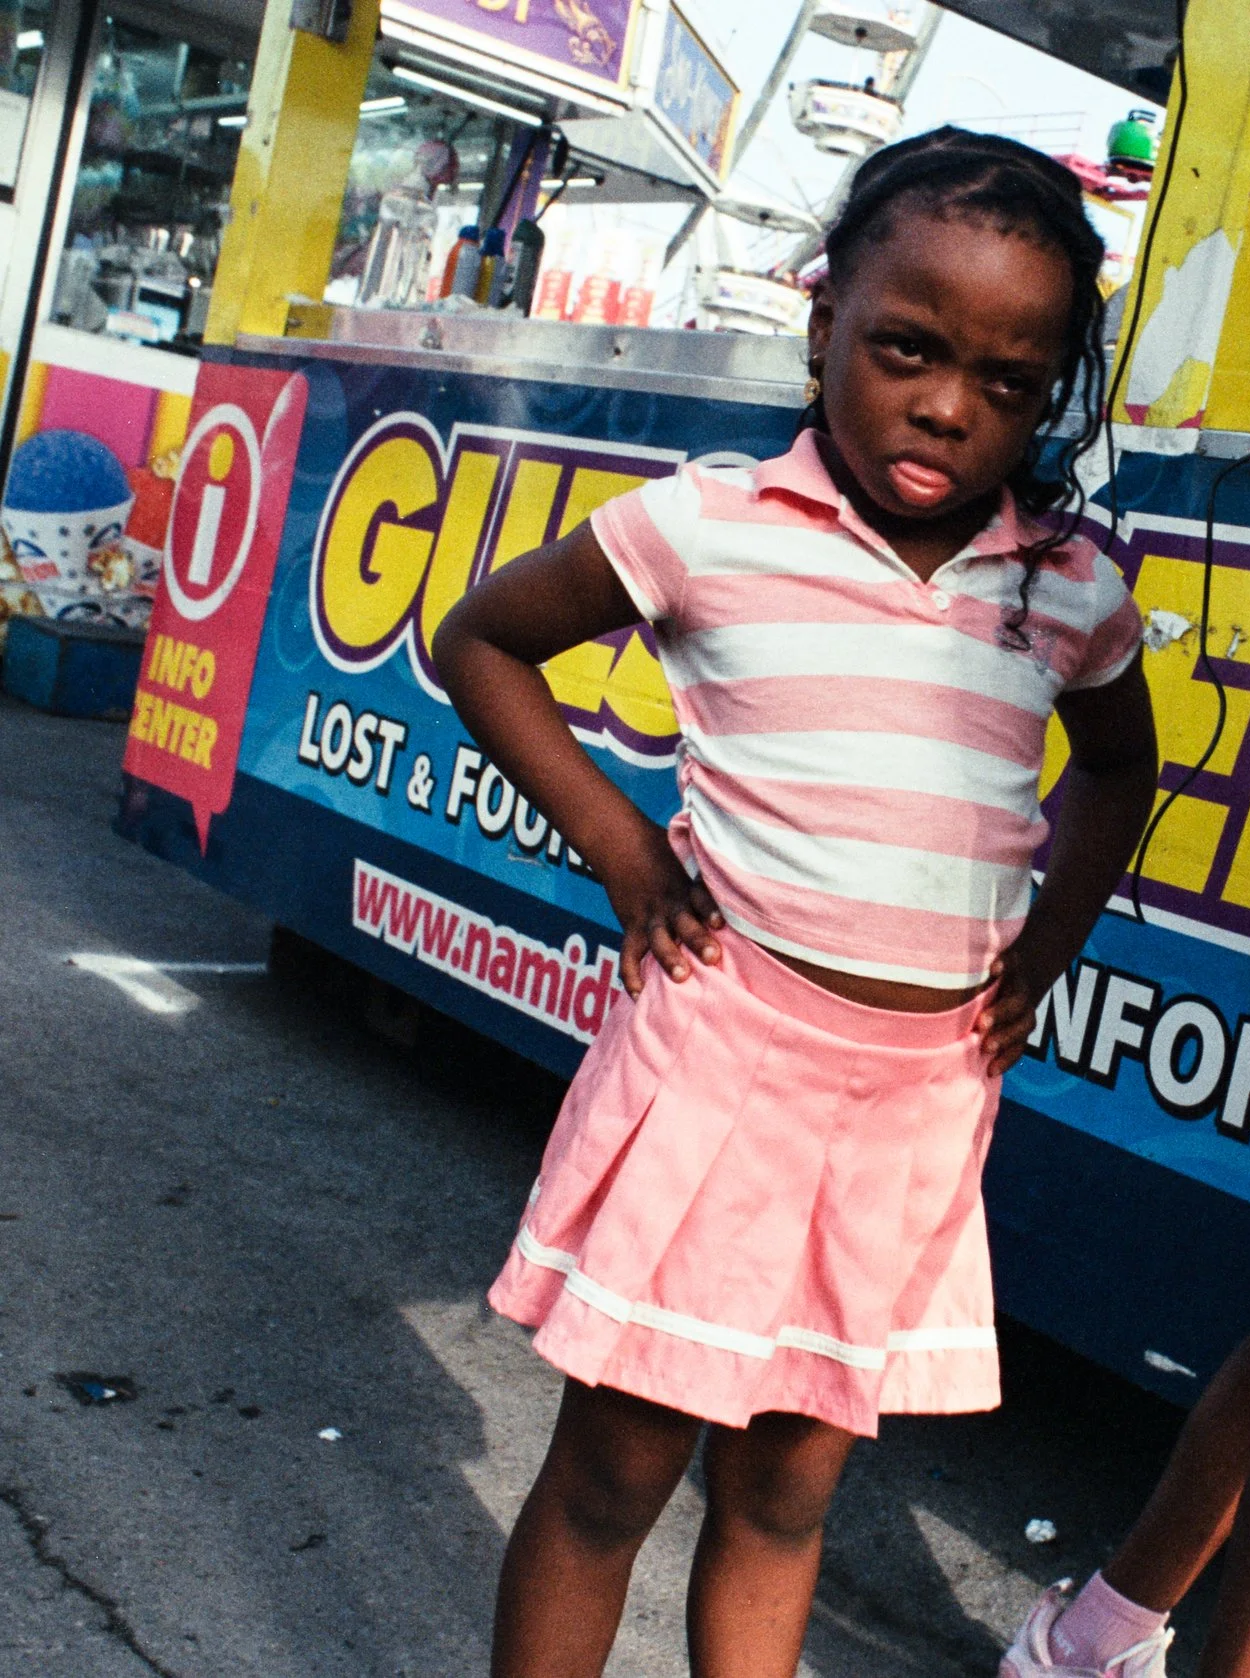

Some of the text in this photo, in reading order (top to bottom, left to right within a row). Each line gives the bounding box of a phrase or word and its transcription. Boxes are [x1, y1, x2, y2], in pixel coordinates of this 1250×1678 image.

[147, 634, 217, 700] INFO
[298, 692, 593, 874] LOST & FOU
[355, 868, 620, 1038] www.namid
